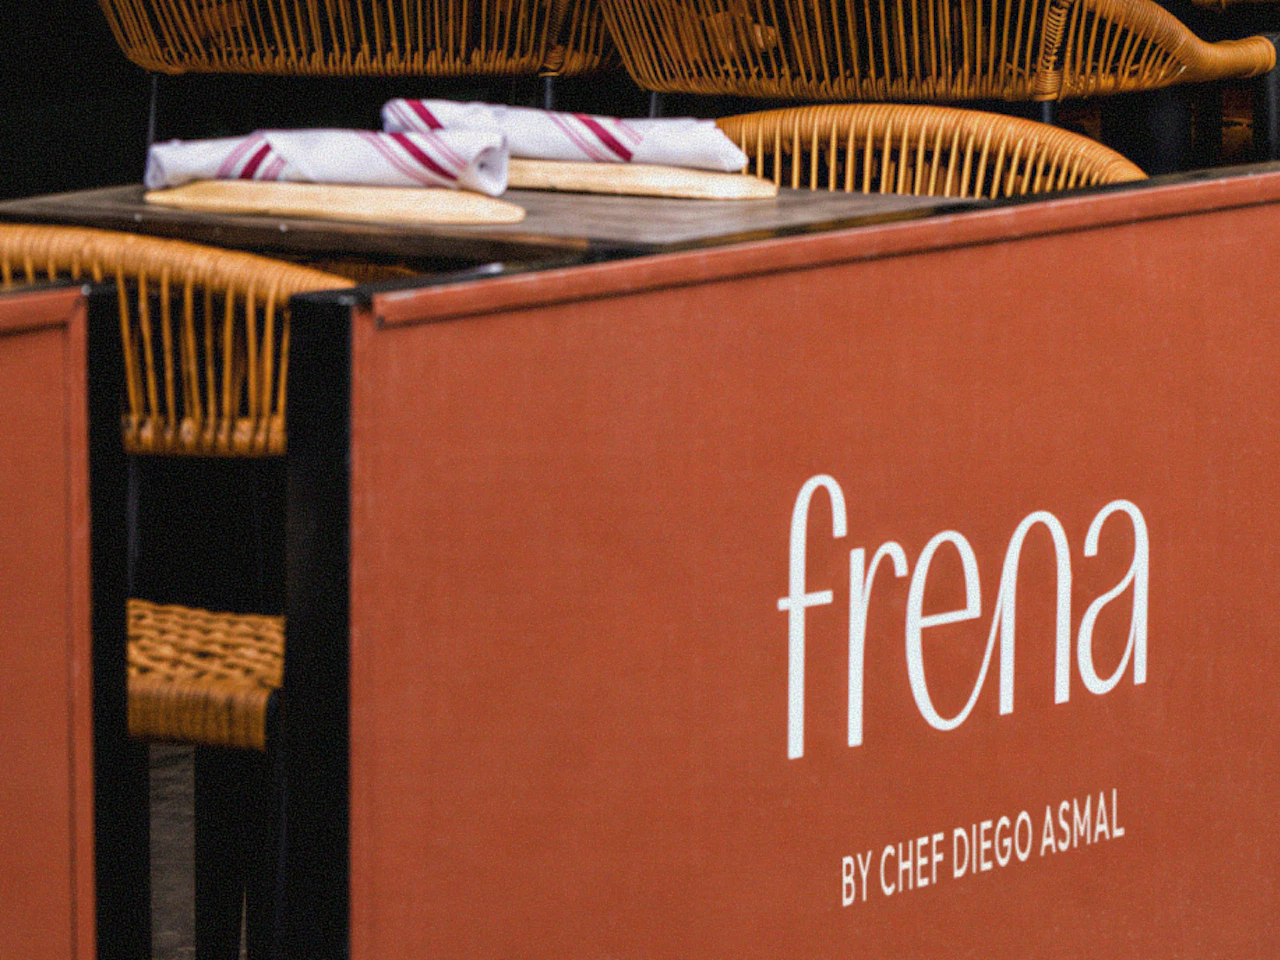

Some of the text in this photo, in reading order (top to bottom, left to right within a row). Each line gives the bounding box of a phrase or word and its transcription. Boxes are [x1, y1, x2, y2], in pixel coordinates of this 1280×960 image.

[777, 474, 1149, 760] frena
[842, 788, 1125, 907] BY CHEF DIEGO ASMAL
